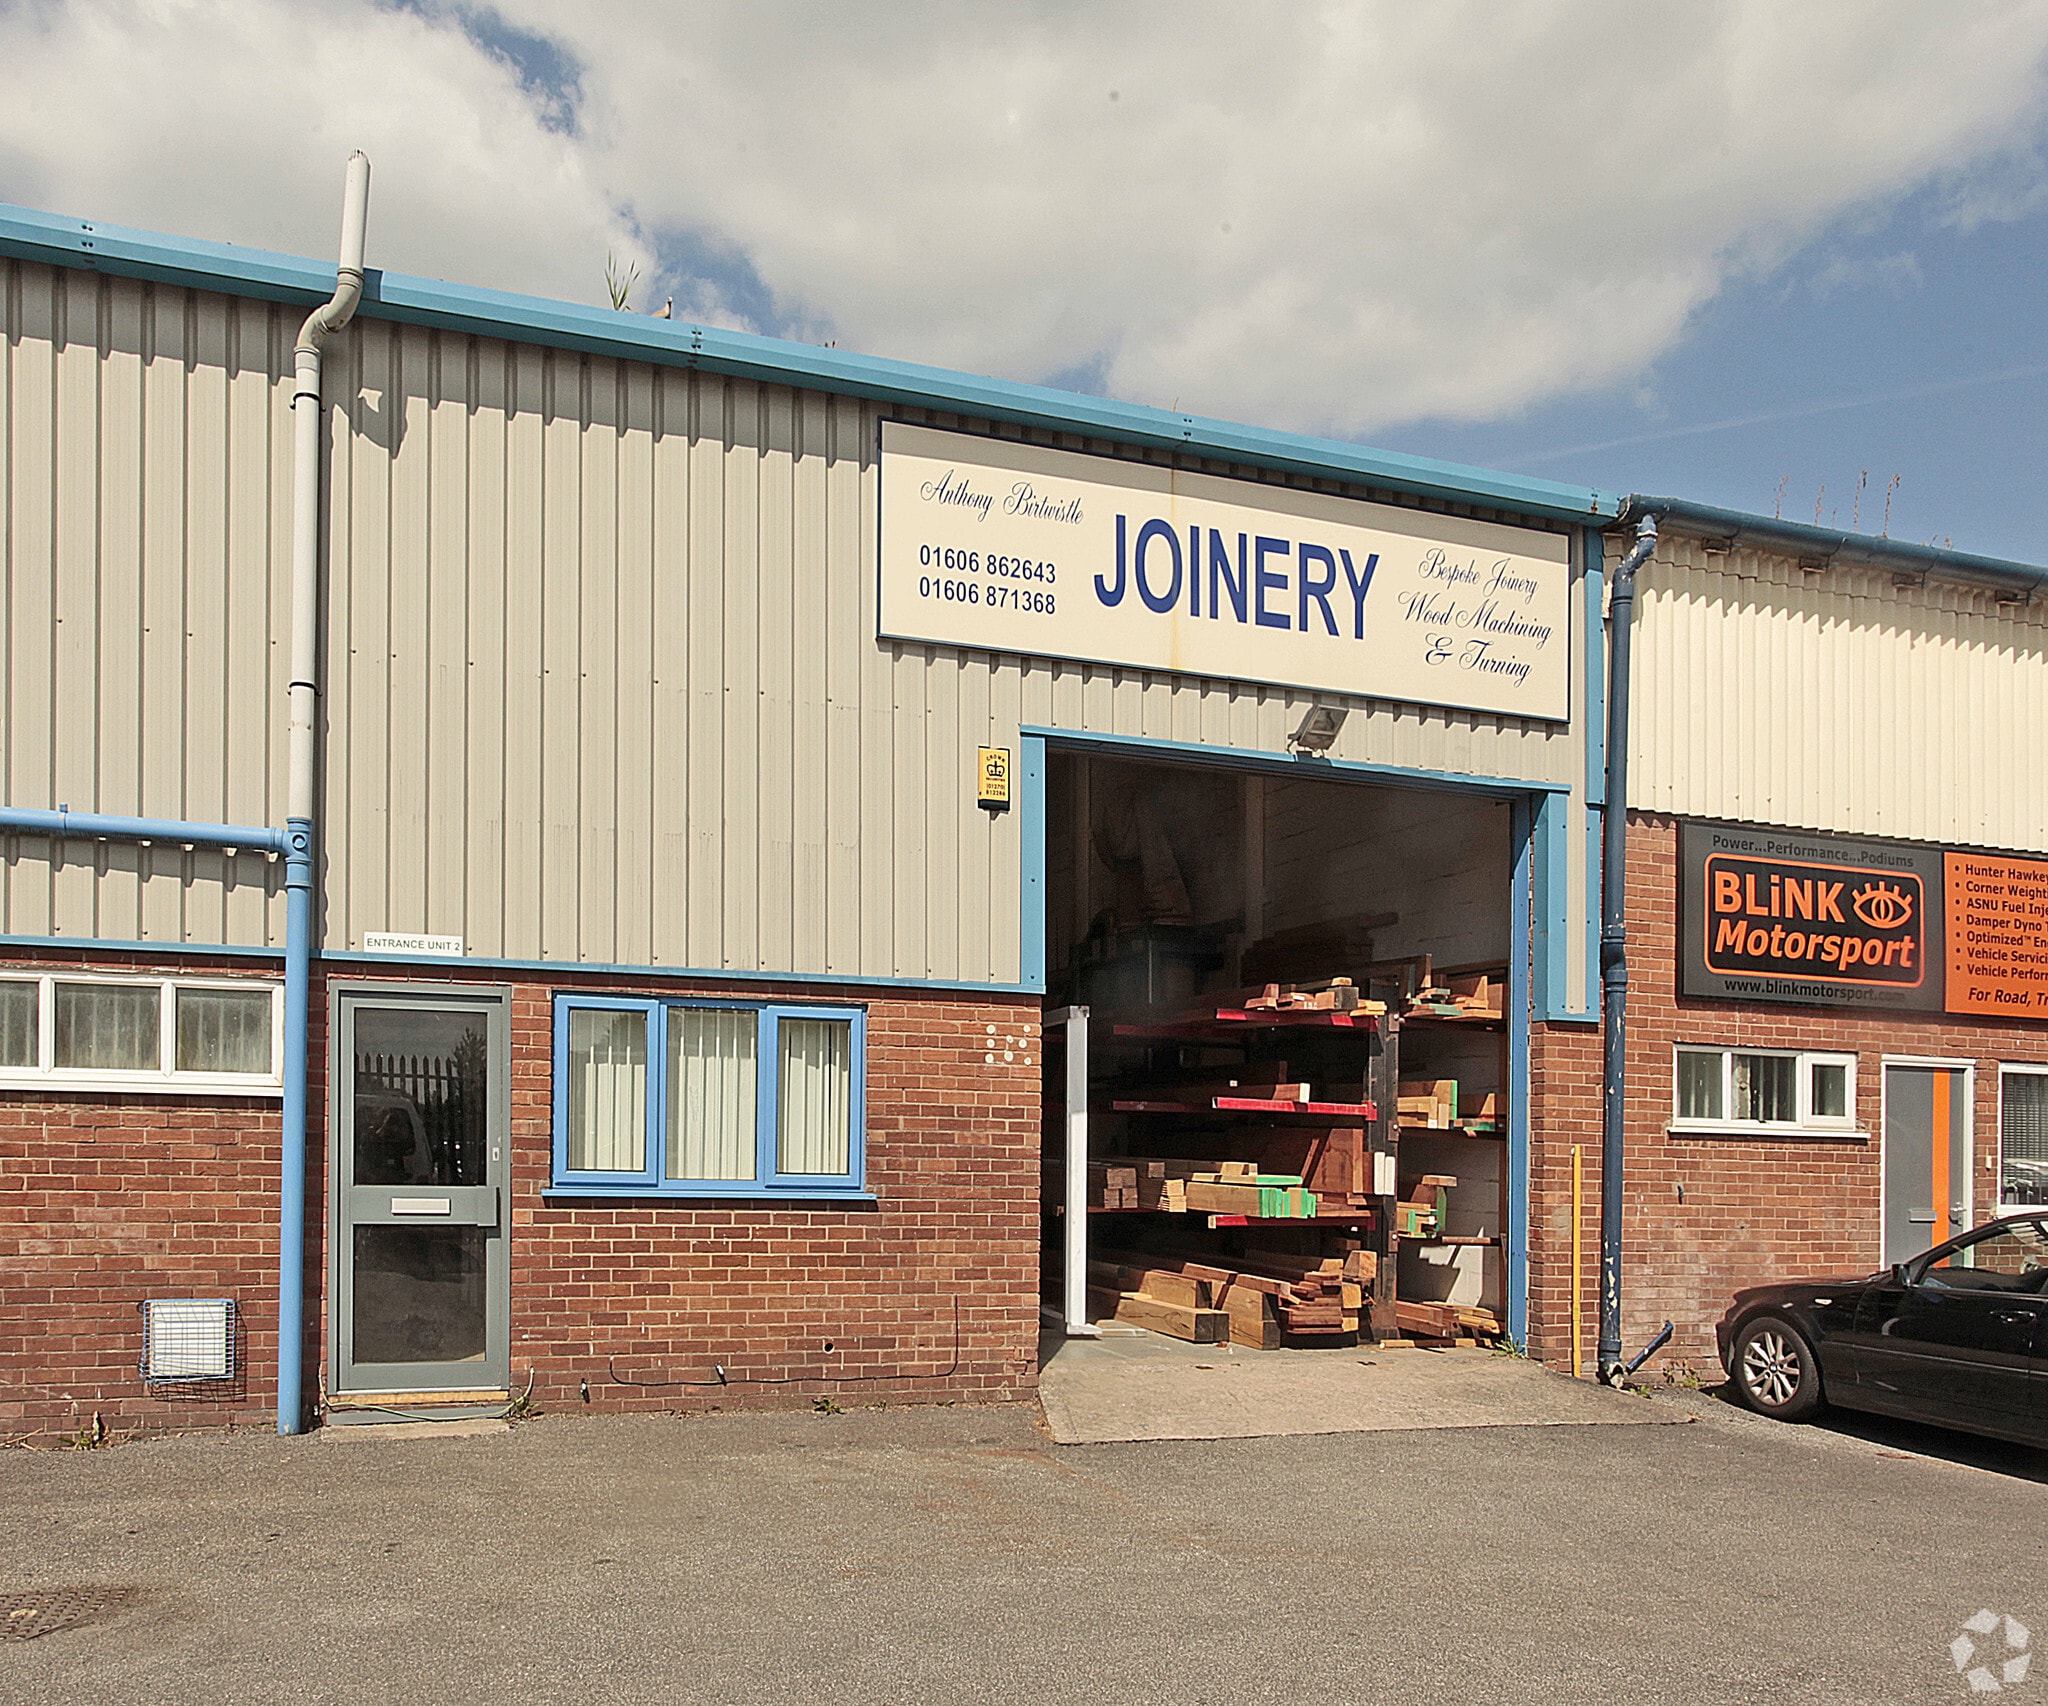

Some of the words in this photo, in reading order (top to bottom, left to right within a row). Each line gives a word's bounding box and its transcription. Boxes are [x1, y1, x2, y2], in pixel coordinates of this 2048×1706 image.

[920, 469, 995, 522] Anthony
[1003, 482, 1084, 524] Birtwistle
[920, 545, 979, 572] 01606
[986, 554, 1056, 584] 862643
[1093, 514, 1380, 640] JOINERY
[1418, 548, 1480, 589] Bespoke
[1483, 557, 1539, 605] Joinery
[919, 576, 979, 604] 01606
[986, 585, 1055, 614] 871368
[1398, 591, 1456, 626] Wood
[1455, 599, 1553, 650] Machining
[1425, 633, 1453, 665] &
[1459, 639, 1533, 688] Turning
[1965, 864, 2004, 878] Hunter
[1714, 870, 1846, 923] BLiNK
[1966, 881, 2004, 895] Corner
[1966, 898, 1998, 910] ASNU
[2002, 901, 2025, 913] Fuel
[1966, 914, 2011, 930] Damper
[2014, 918, 2042, 933] Dyno
[366, 938, 425, 949] ENTRANCE
[428, 941, 451, 951] UNIT
[454, 942, 460, 951] 2
[1714, 918, 1915, 971] Motorsport
[1967, 947, 2008, 961] Vehicle
[1967, 964, 2008, 978] Vehicle
[1724, 979, 1906, 1001] www.blinkmotorsport.com
[1968, 987, 1991, 1001] For
[1994, 989, 2031, 1007] Road,
